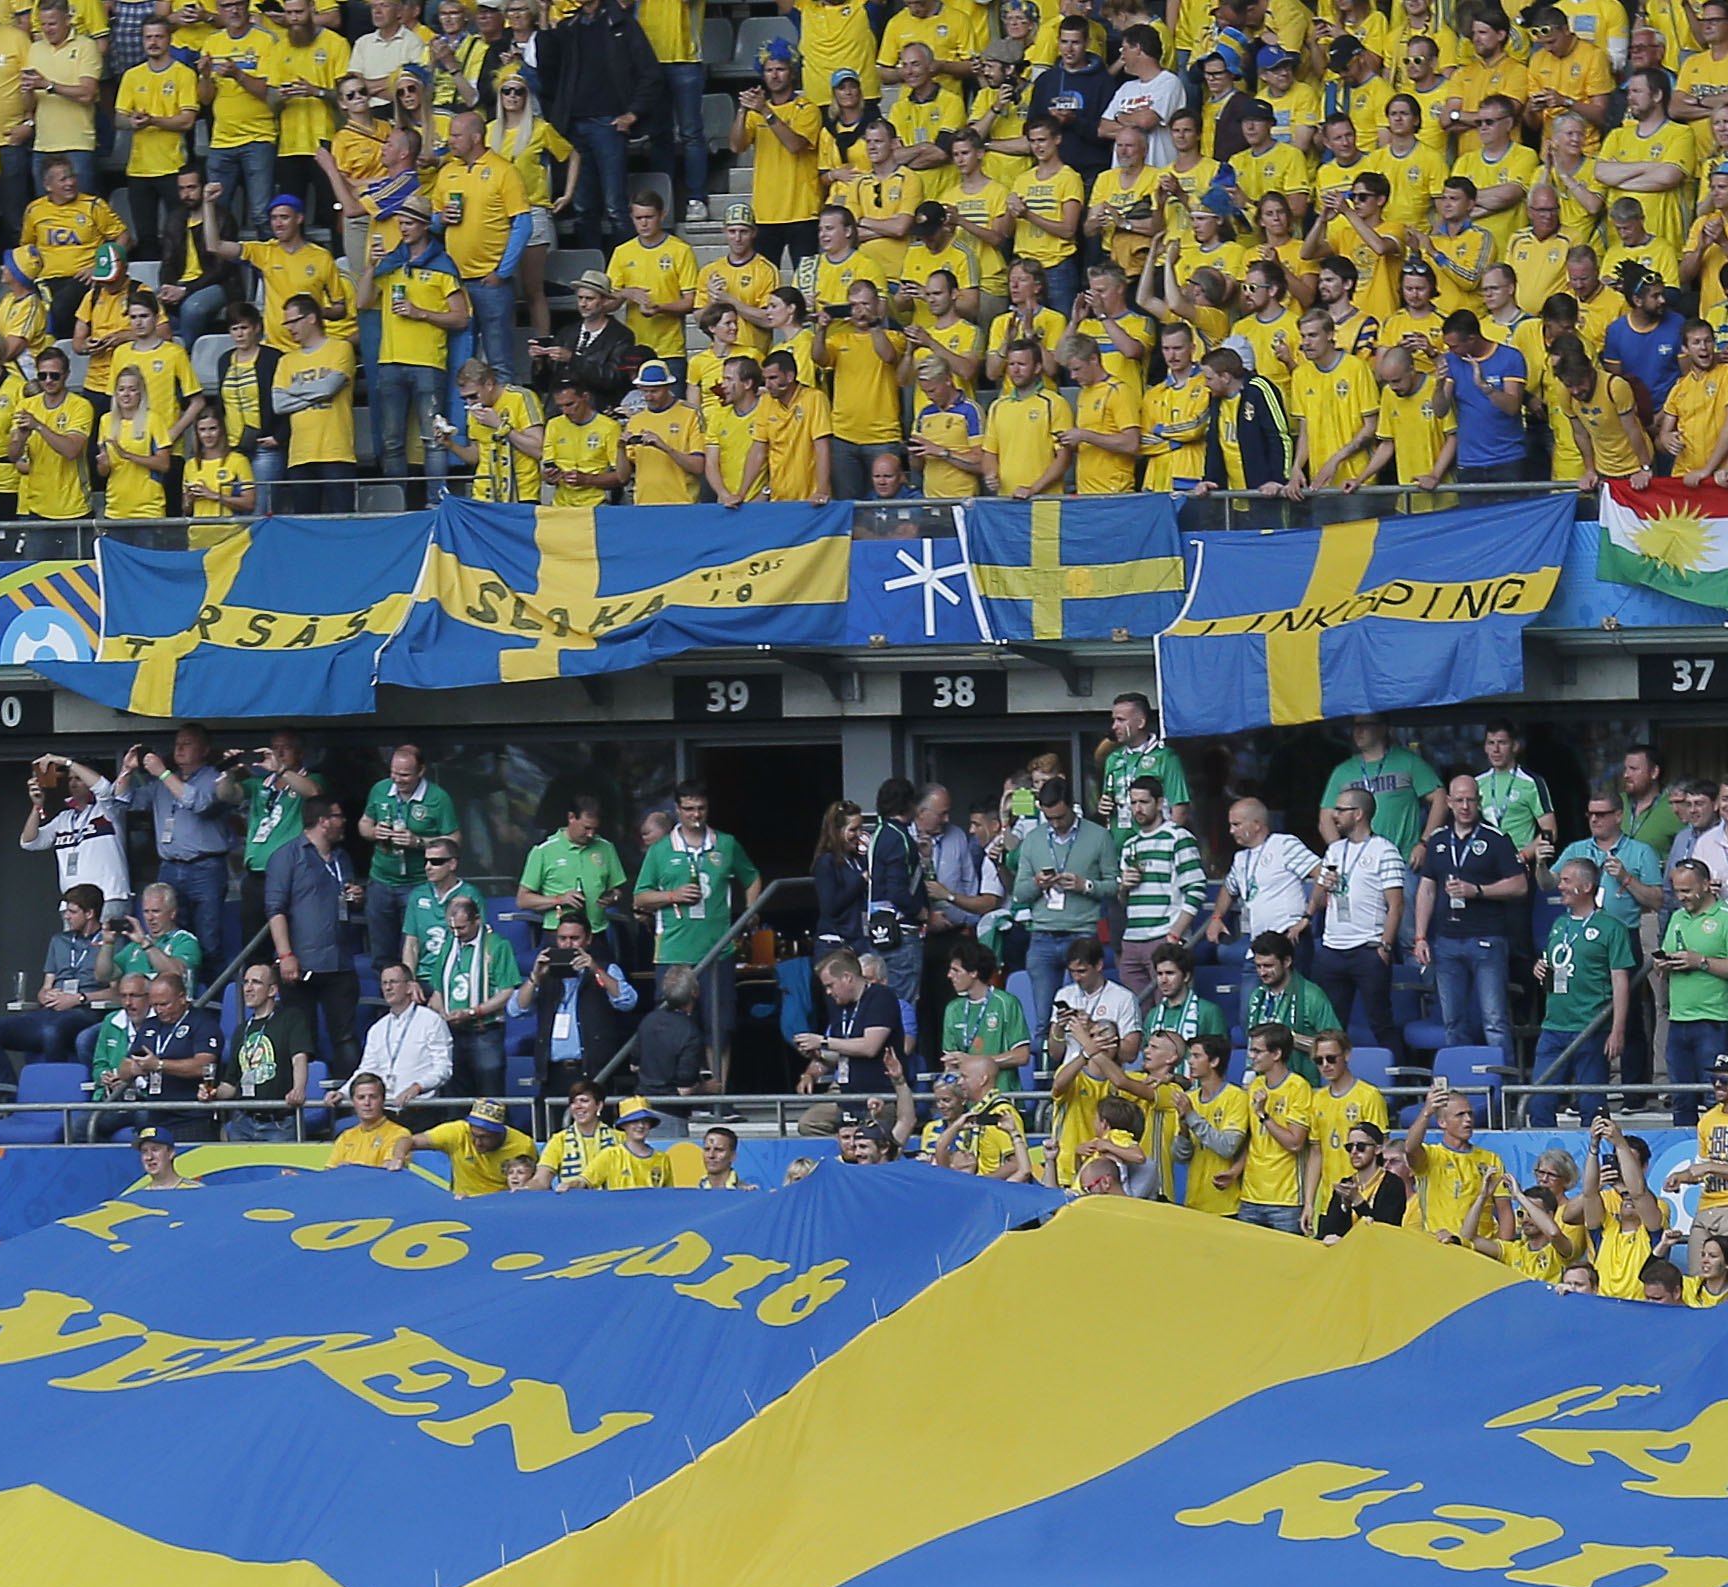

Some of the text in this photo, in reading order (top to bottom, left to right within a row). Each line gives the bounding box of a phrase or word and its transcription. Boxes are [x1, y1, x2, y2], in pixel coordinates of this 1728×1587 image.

[49, 229, 82, 247] ICA
[933, 675, 976, 708] 38
[1672, 659, 1715, 692] 37
[706, 680, 750, 713] 39
